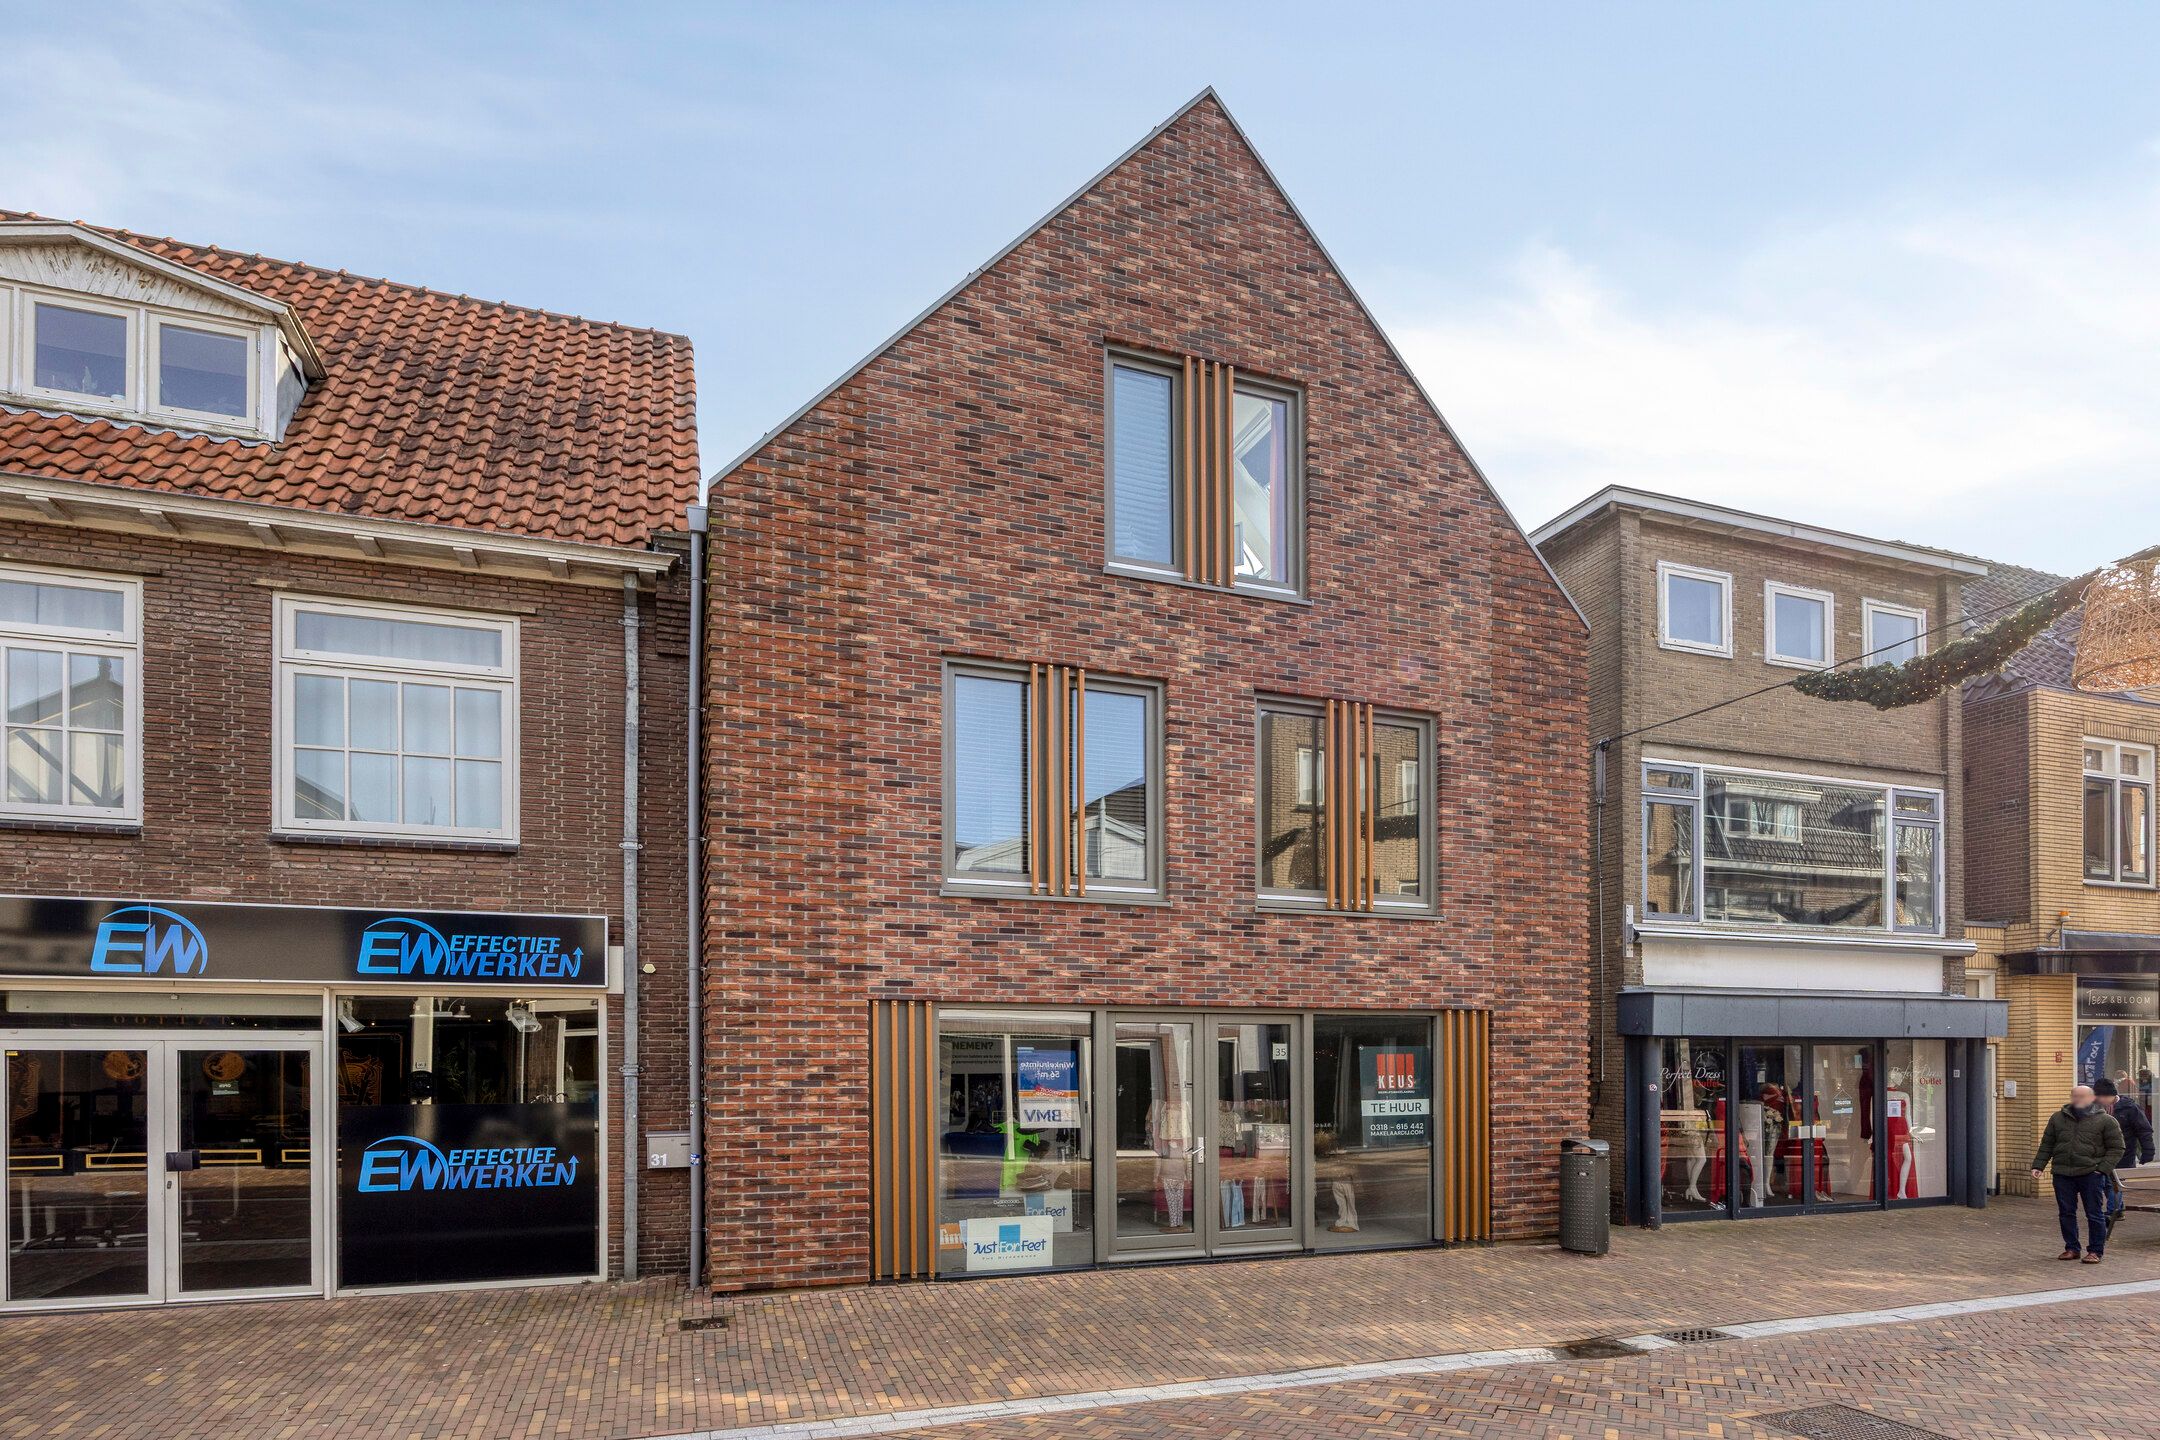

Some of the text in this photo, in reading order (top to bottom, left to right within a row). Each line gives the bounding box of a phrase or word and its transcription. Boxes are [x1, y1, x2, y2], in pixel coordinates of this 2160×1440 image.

[90, 921, 200, 974] EW
[450, 934, 560, 954] EFFECTIEF
[357, 931, 444, 975] EW
[450, 951, 578, 978] WERKEN
[1275, 1048, 1287, 1057] 35
[1378, 1074, 1414, 1089] KEUS
[1694, 1067, 1721, 1080] Dress
[1371, 1102, 1422, 1113] TE HUUR
[1370, 1123, 1388, 1131] 0318
[449, 1147, 557, 1167] EFFECTIEF
[651, 1154, 667, 1166] 31
[358, 1149, 444, 1193] EW
[449, 1162, 573, 1190] WERKEN
[1045, 1206, 1067, 1217] Feet
[973, 1242, 998, 1255] Just
[1021, 1238, 1047, 1252] Feet
